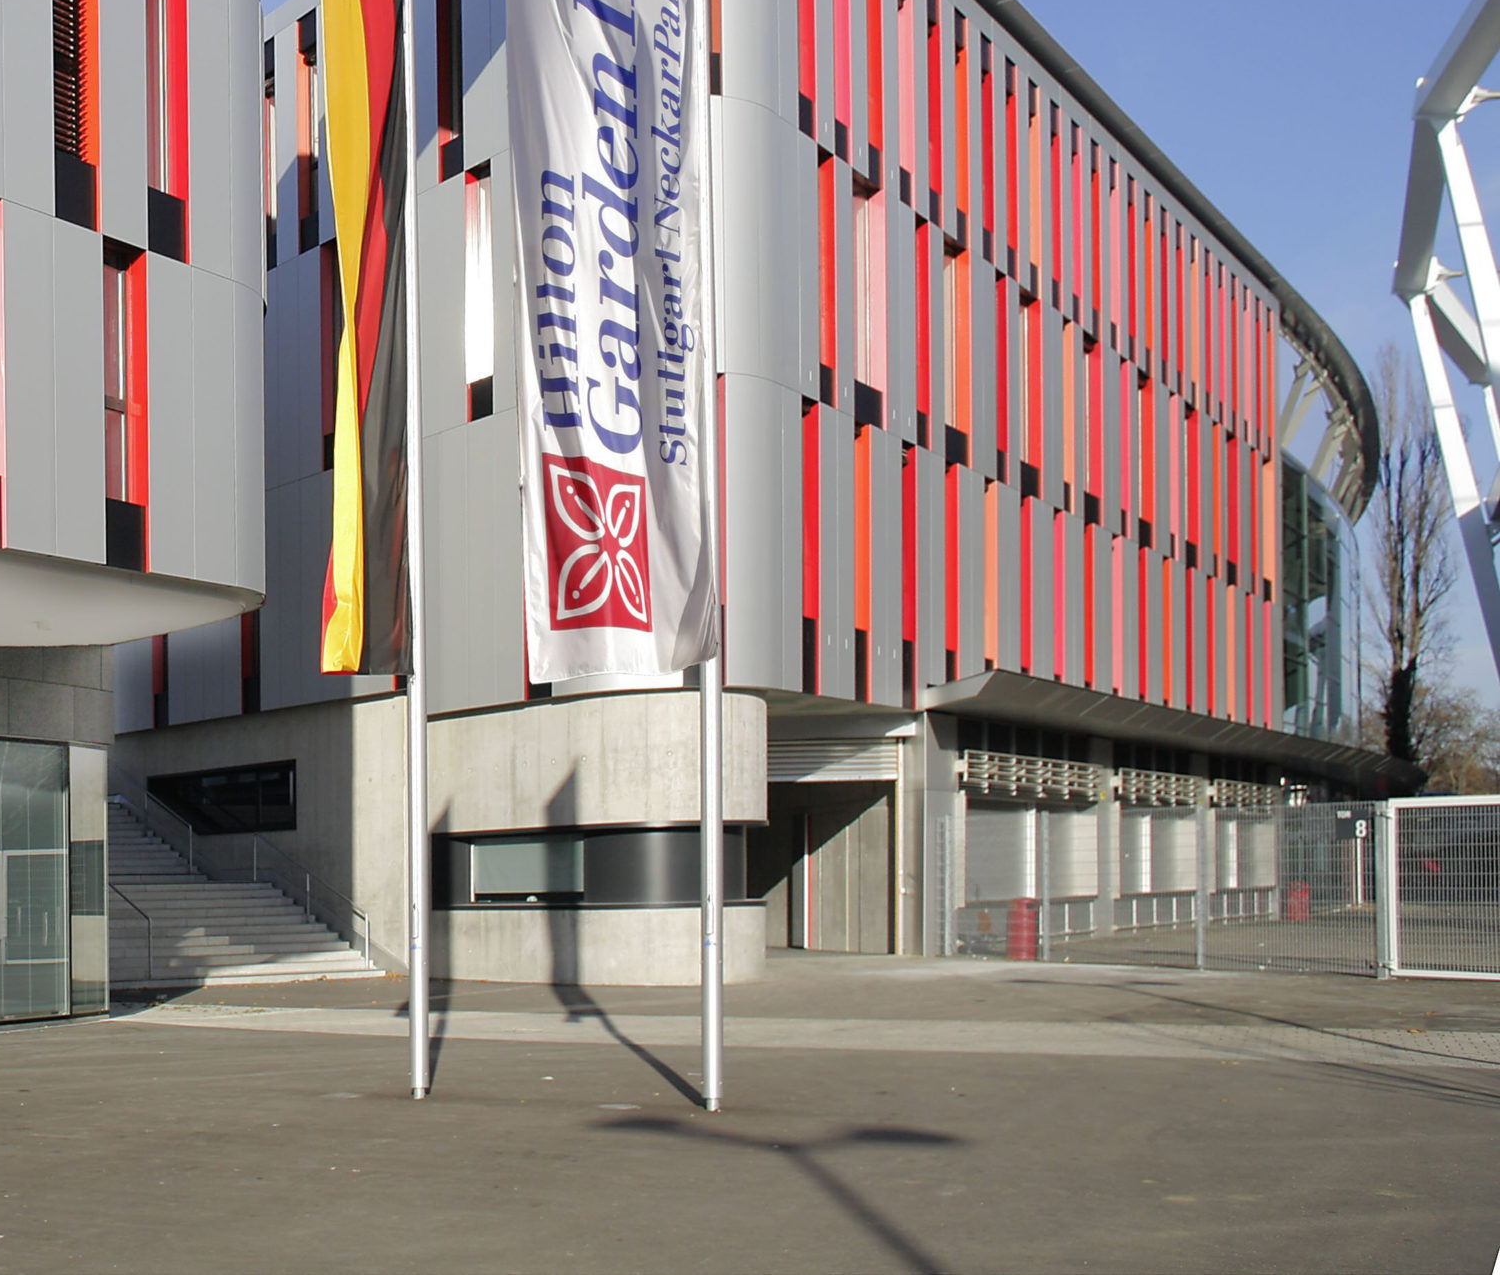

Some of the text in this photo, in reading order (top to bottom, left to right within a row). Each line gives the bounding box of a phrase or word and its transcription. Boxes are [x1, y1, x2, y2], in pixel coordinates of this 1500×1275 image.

[537, 170, 583, 430] Hilton
[582, 53, 643, 454] Garden
[655, 245, 695, 466] Stuttgart
[1355, 819, 1367, 837] 8
